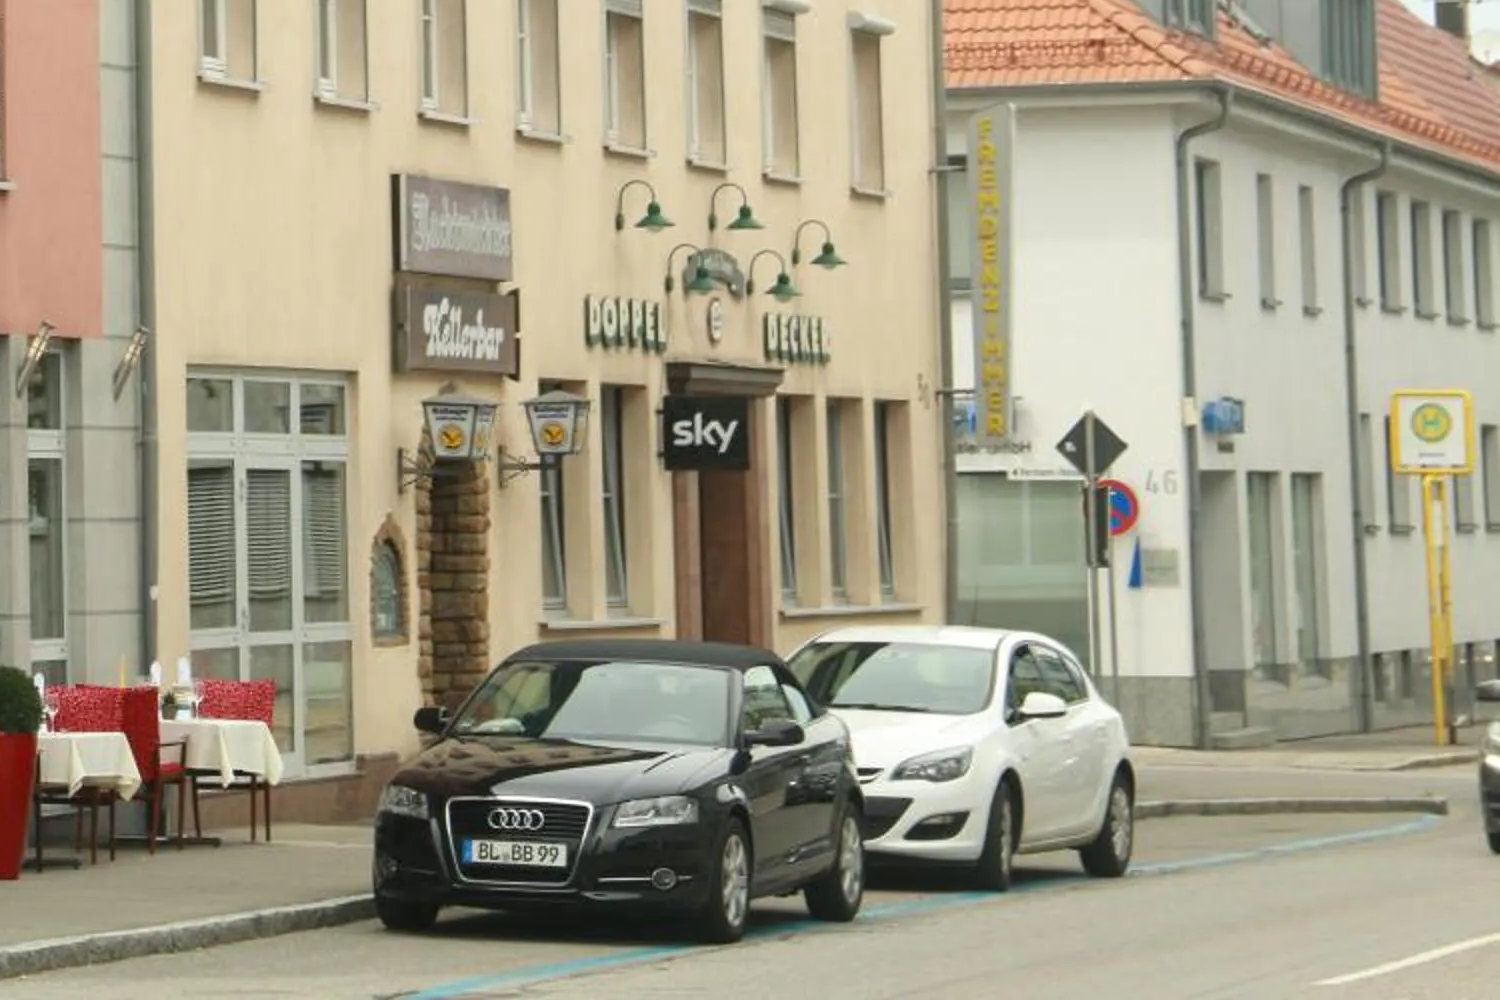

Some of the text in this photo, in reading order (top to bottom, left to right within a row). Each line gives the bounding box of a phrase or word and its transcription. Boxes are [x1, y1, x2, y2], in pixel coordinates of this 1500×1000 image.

[423, 297, 504, 360] Kellerbar
[585, 294, 667, 350] DOPPEL
[764, 312, 831, 363] DECKER
[672, 412, 738, 453] sky
[1145, 469, 1177, 496] 46
[478, 843, 559, 863] BL BB 99
